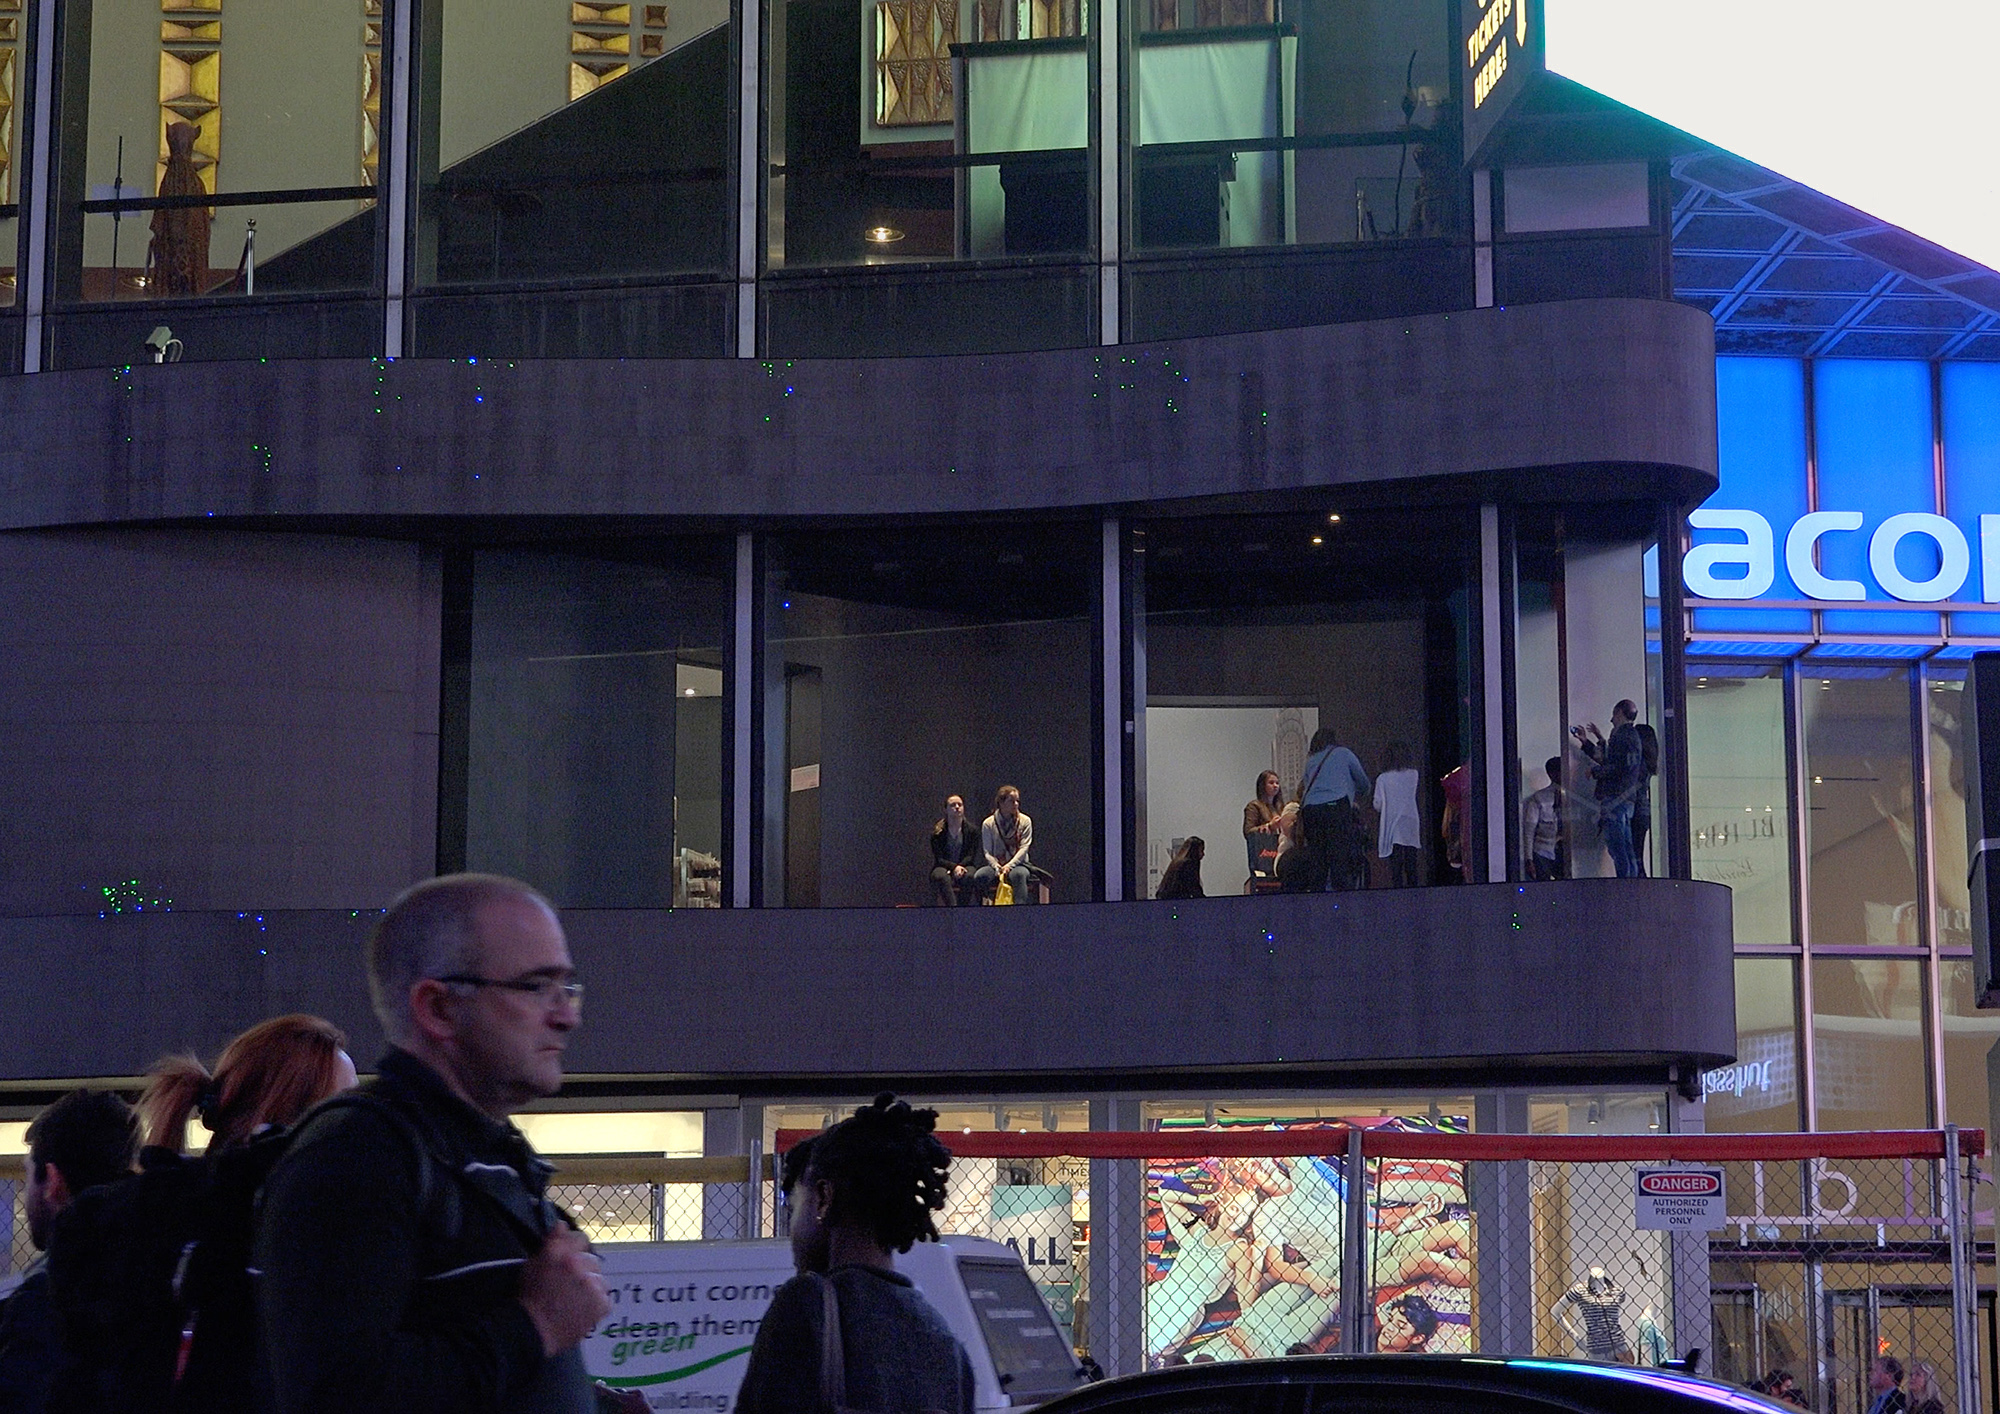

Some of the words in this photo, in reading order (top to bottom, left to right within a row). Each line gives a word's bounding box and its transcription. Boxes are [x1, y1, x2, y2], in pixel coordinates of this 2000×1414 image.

[1467, 0, 1512, 68] TICKETS
[1474, 36, 1508, 109] HERE!
[1644, 508, 2000, 603] aco
[1061, 1168, 1089, 1176] TIME
[1650, 1178, 1709, 1190] DANGER
[1655, 1208, 1706, 1216] PERSONNEL
[1669, 1217, 1692, 1225] ONLY
[653, 1283, 697, 1303] cut
[605, 1316, 680, 1338] clean
[611, 1333, 696, 1366] green
